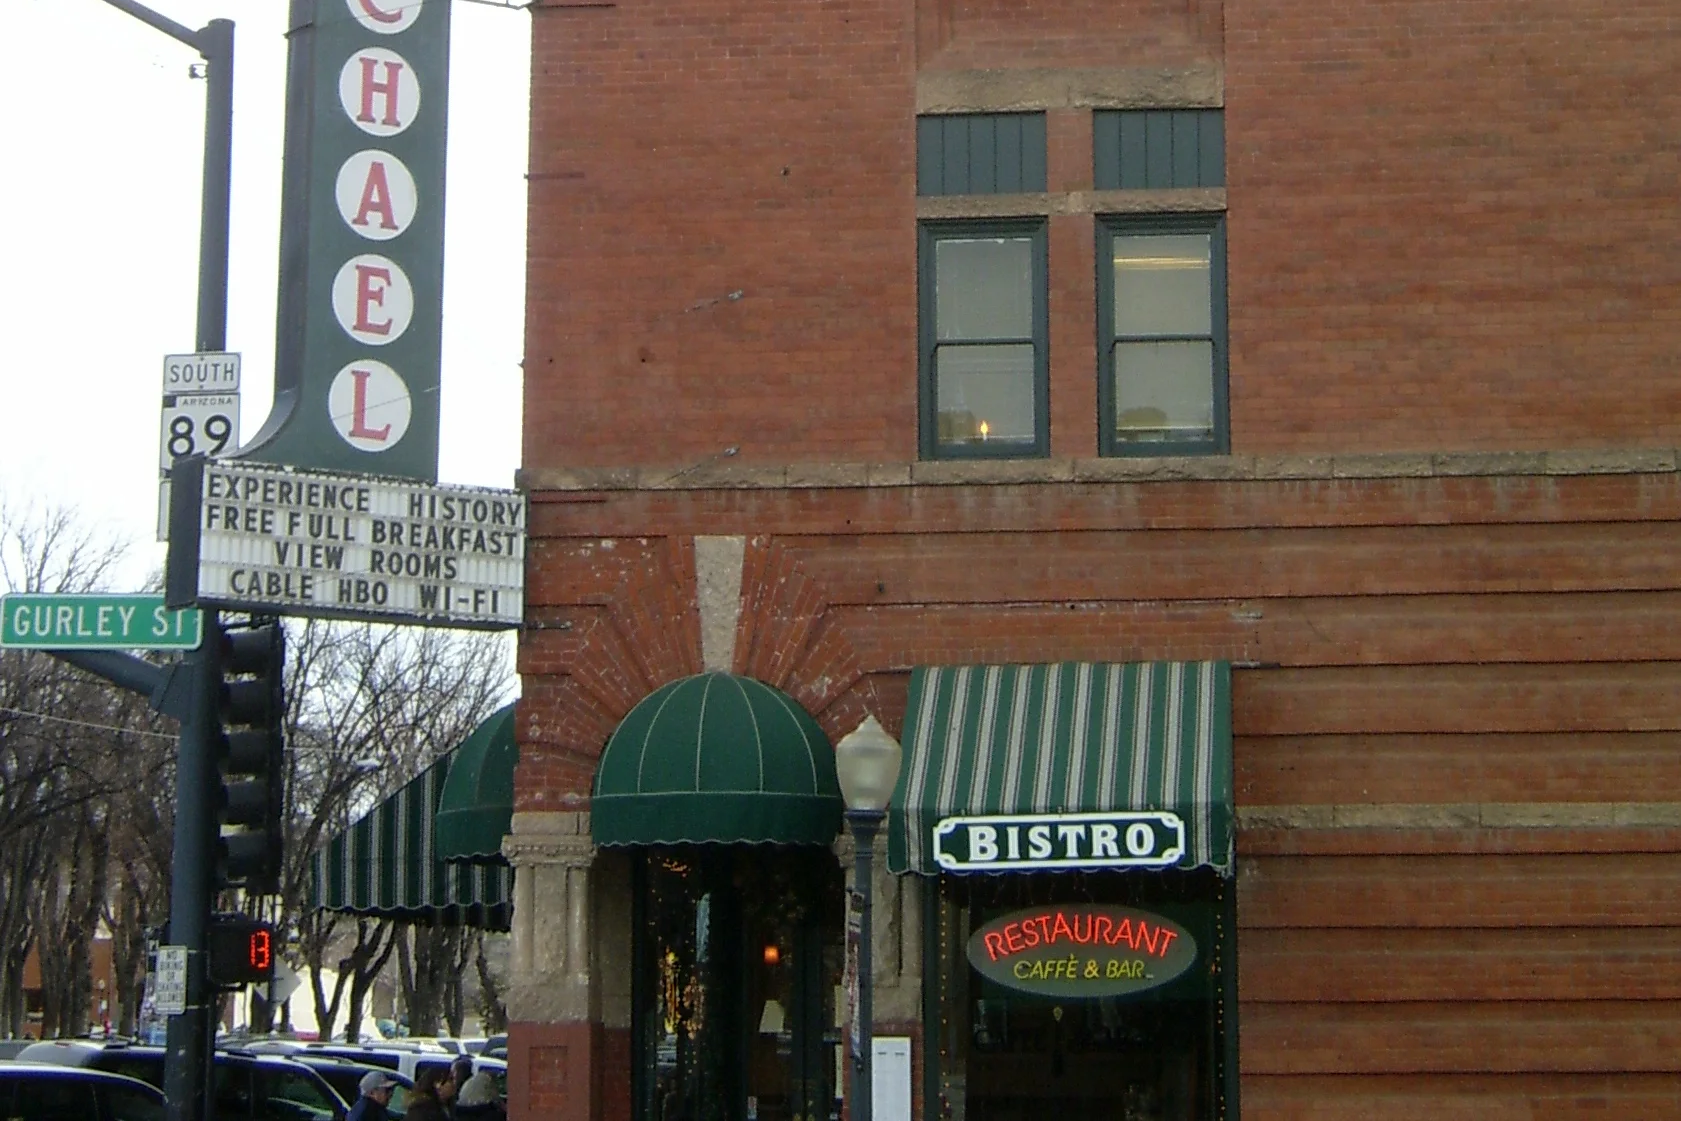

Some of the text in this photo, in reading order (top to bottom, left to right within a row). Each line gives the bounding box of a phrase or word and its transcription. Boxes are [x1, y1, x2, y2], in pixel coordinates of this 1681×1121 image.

[170, 363, 234, 383] SOUTH
[182, 397, 232, 406] ARIZONA
[168, 414, 232, 458] 89
[207, 474, 522, 526] EXPERIENCE HISTORY
[206, 504, 517, 556] FREE FULL BREAKFAST
[275, 542, 457, 580] VIEW ROOMS
[230, 570, 499, 613] CABLE HBO WI-FI
[13, 605, 187, 637] GURLEY ST
[968, 823, 1155, 862] BISTRO
[983, 912, 1178, 961] RESTAURANT
[1084, 960, 1099, 978] &
[1106, 960, 1145, 978] BAR
